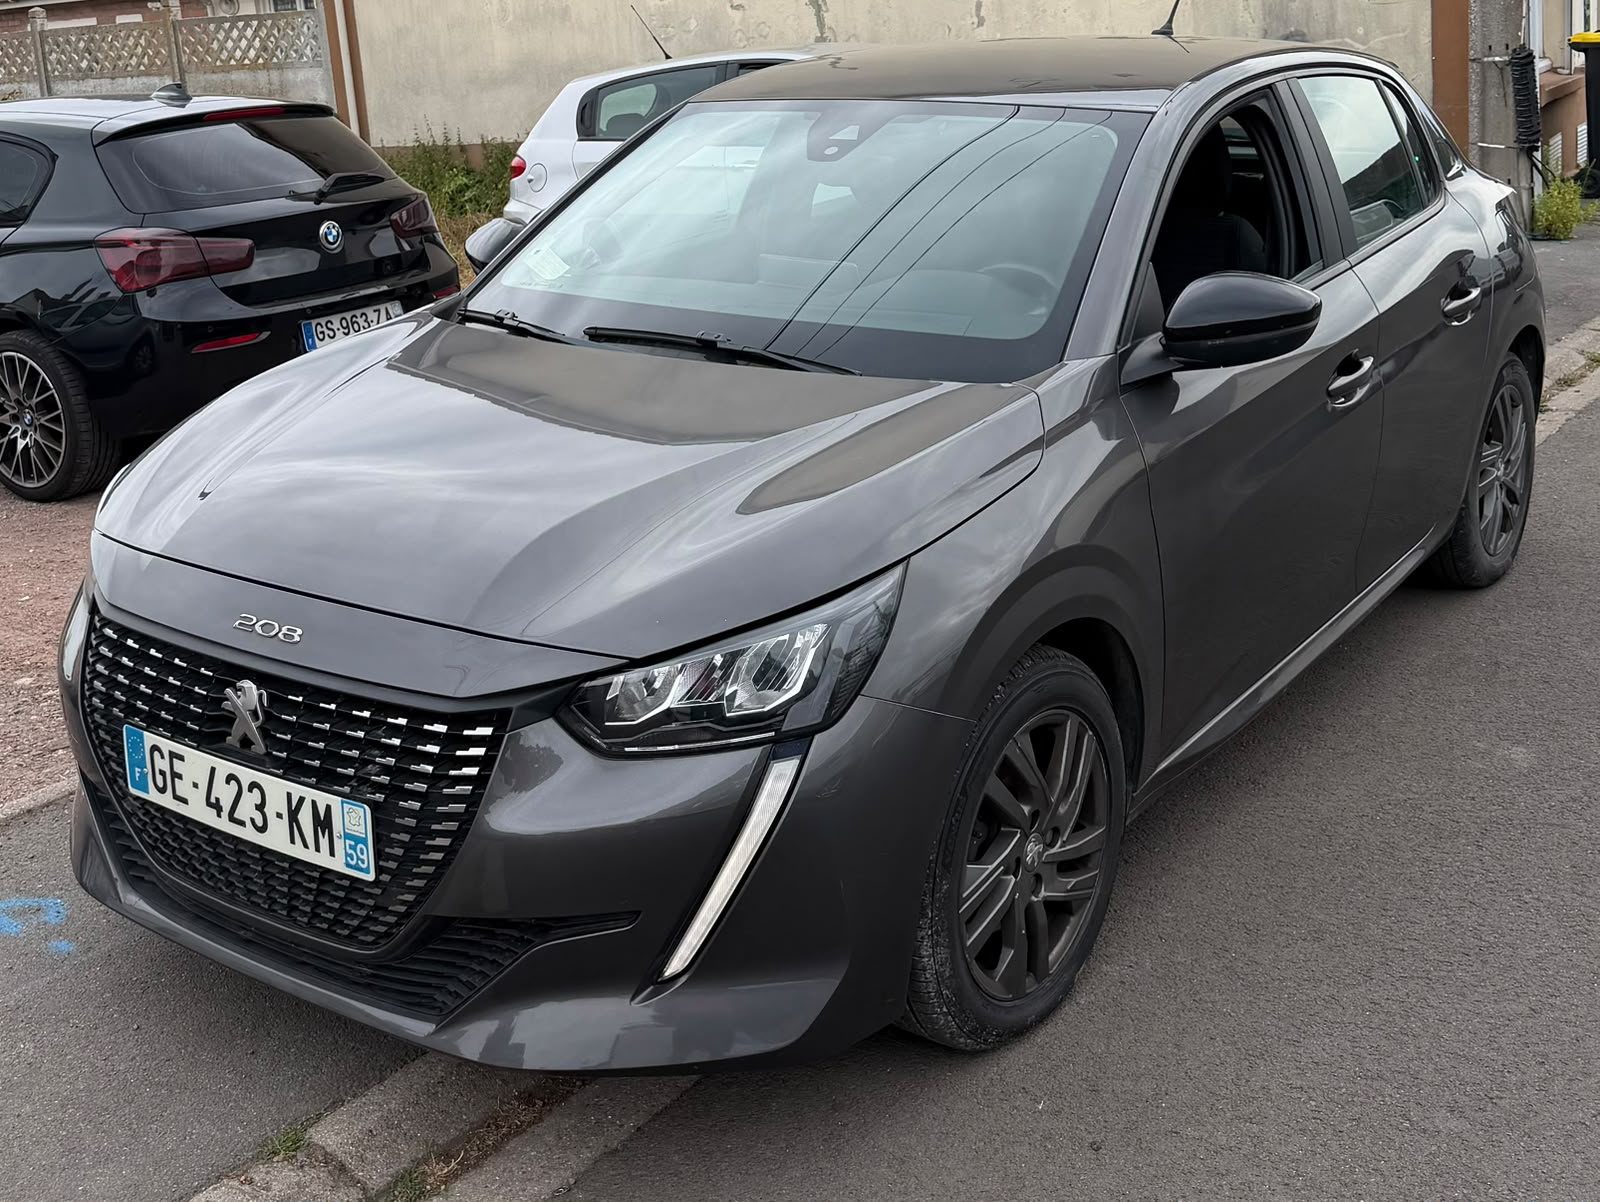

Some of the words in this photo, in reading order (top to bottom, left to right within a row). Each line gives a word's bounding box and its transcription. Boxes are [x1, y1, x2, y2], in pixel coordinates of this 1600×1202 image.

[233, 613, 303, 643] 208
[135, 767, 141, 781] F
[149, 744, 336, 859] GE-423-KM
[345, 842, 368, 869] 59
